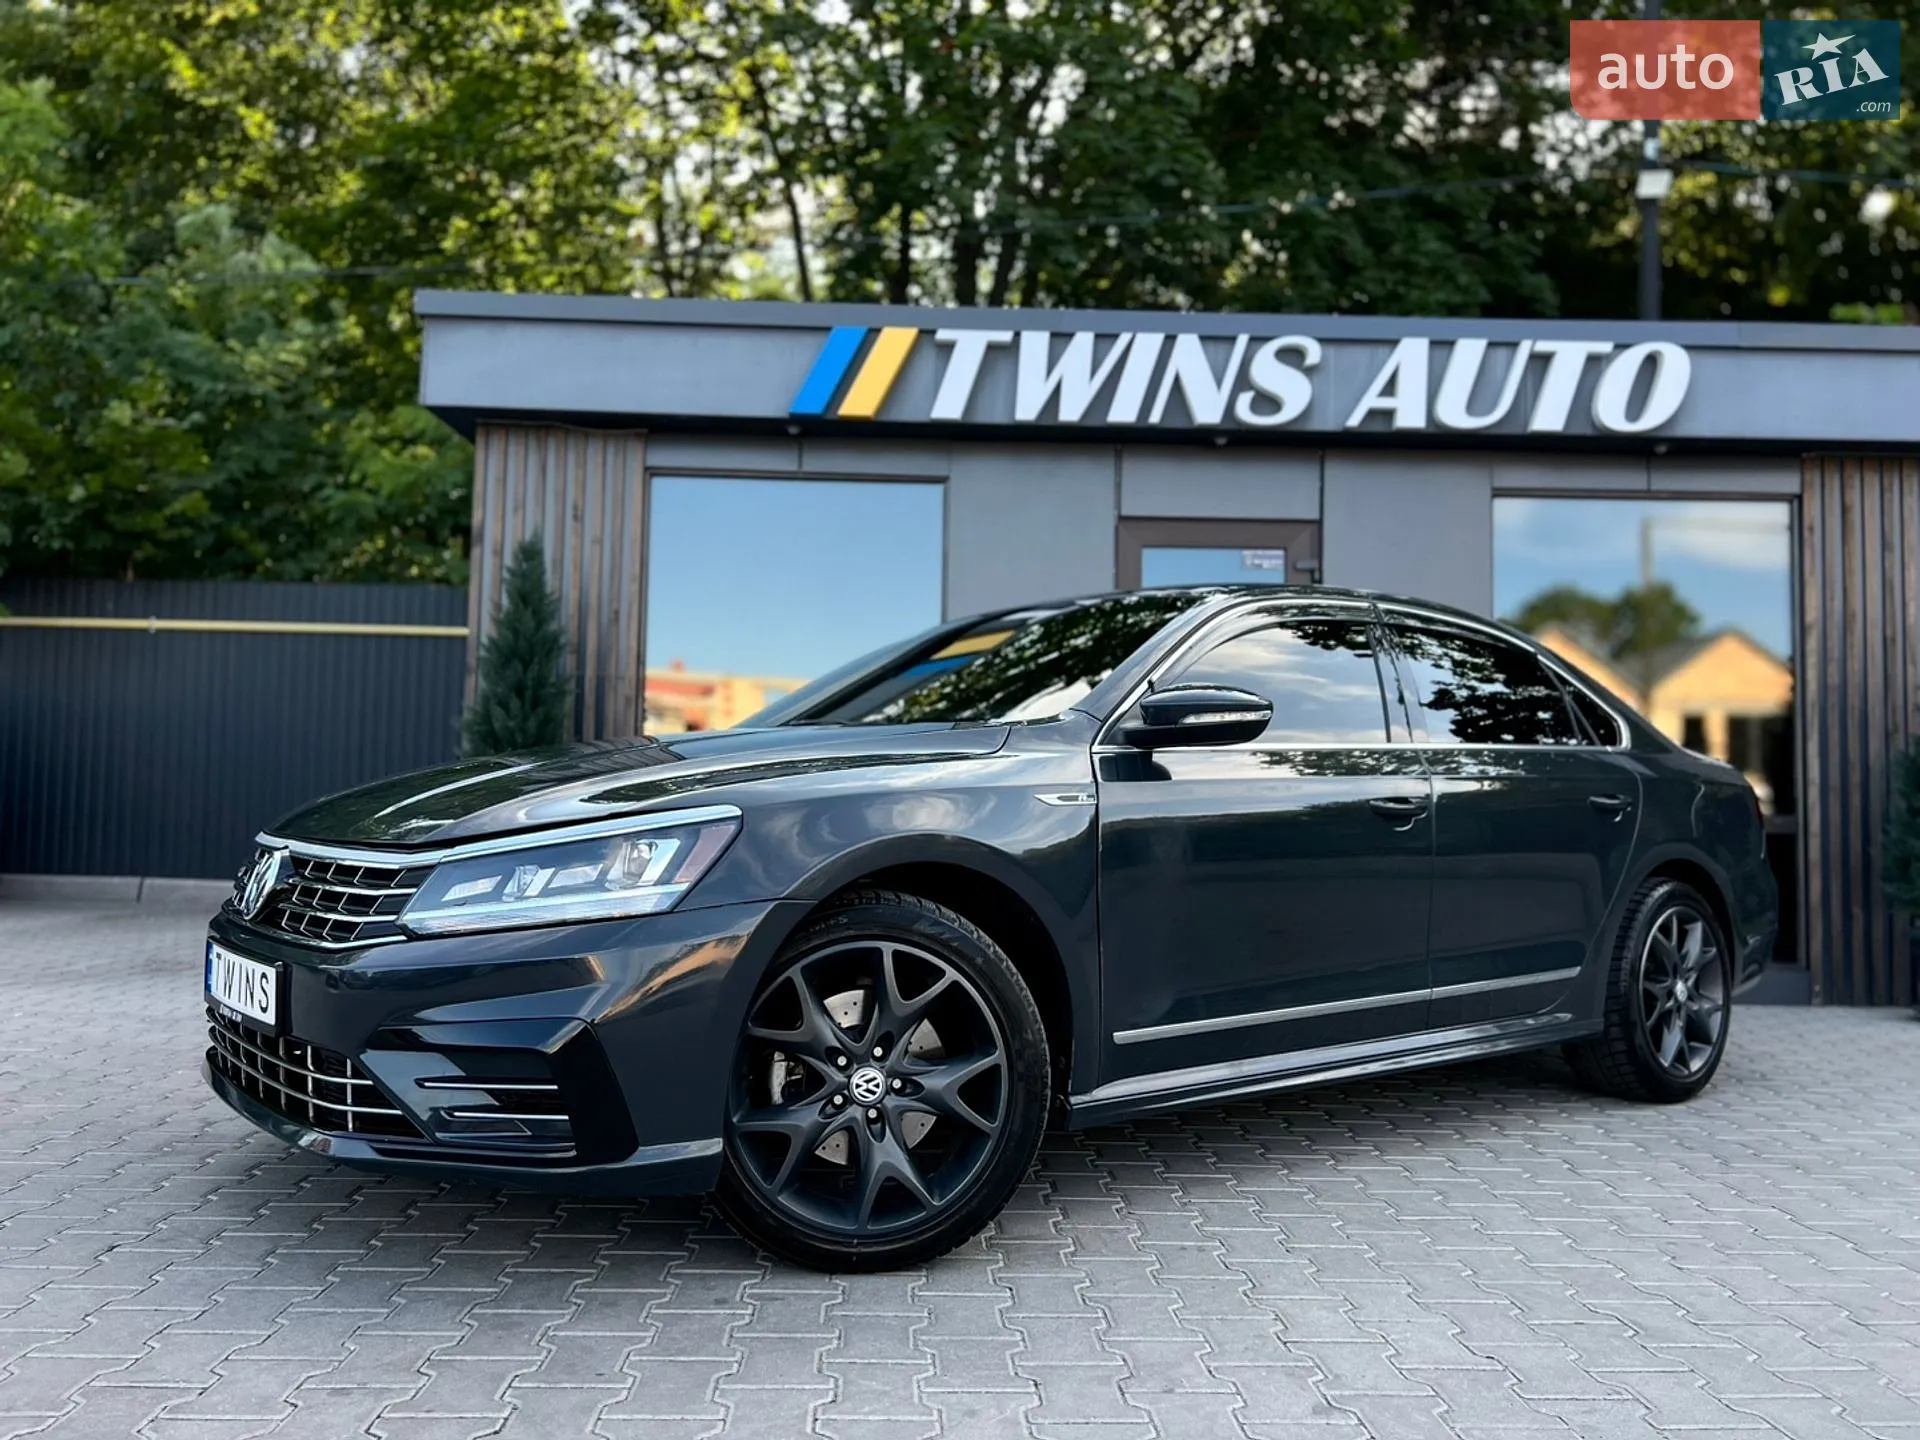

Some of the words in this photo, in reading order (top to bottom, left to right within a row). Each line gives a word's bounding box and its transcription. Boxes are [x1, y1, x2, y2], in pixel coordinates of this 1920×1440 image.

[929, 328, 1323, 427] TWINS
[1343, 336, 1692, 433] AUTO
[215, 951, 270, 1014] TWINS
